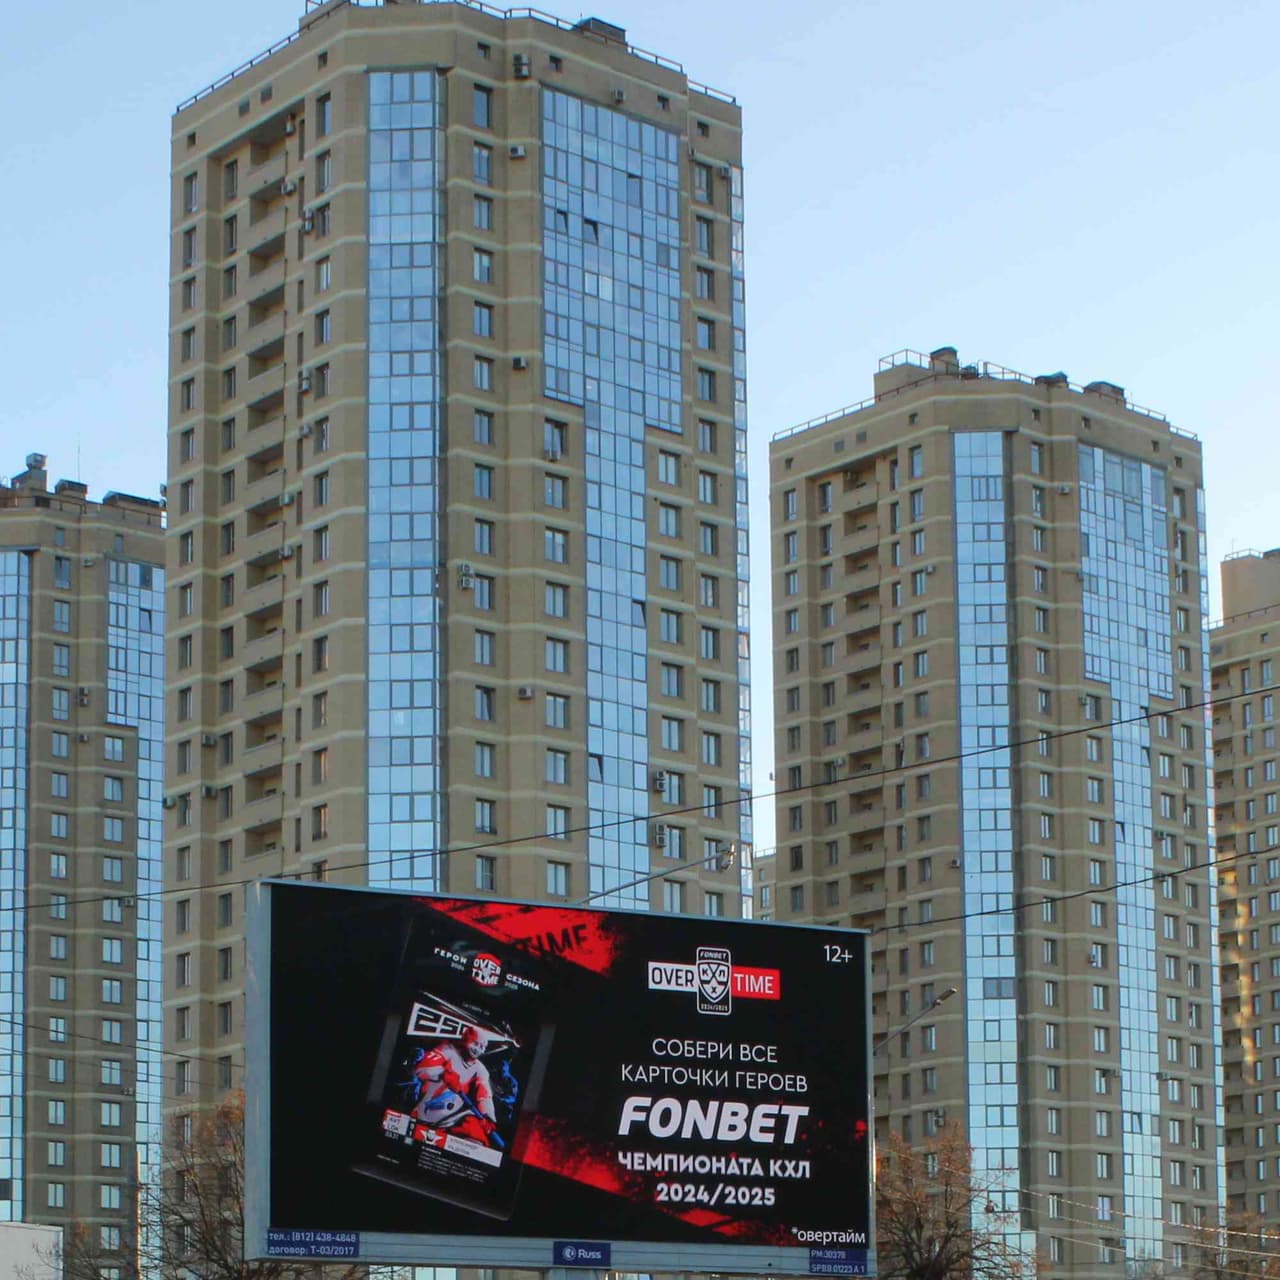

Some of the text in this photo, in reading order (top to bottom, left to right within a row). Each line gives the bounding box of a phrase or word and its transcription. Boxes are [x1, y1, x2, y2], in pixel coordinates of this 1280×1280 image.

[700, 951, 727, 960] FONBET
[823, 945, 854, 963] 12+
[650, 966, 695, 988] OVER
[733, 973, 774, 994] TIME
[652, 1038, 778, 1063] СОБЕРИ ВСЕ
[621, 1063, 808, 1093] КАРТОЧКИ ГЕРОЕВ
[618, 1096, 810, 1144] FONBET
[618, 1151, 811, 1179] ЧЕМПИОНАТА КХЛ
[655, 1182, 776, 1206] 2024/2025
[577, 1248, 602, 1259] Russ
